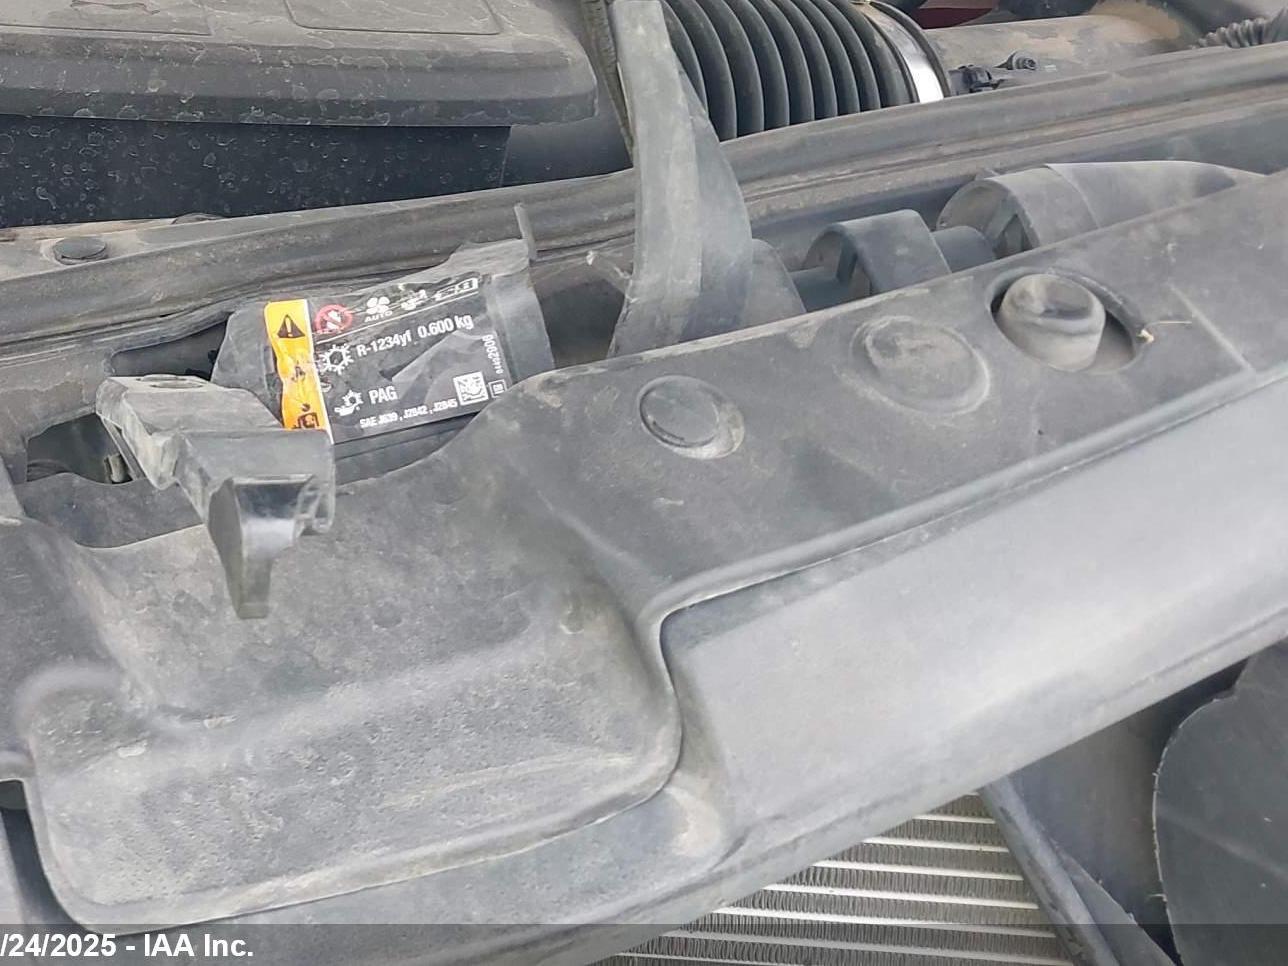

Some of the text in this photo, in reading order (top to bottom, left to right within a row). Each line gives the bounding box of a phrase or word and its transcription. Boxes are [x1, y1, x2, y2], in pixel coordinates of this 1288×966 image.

[364, 310, 393, 323] AUTO
[356, 313, 474, 358] R-1234yf 0.600 kg
[368, 385, 398, 405] PAG
[359, 416, 378, 429] SAE
